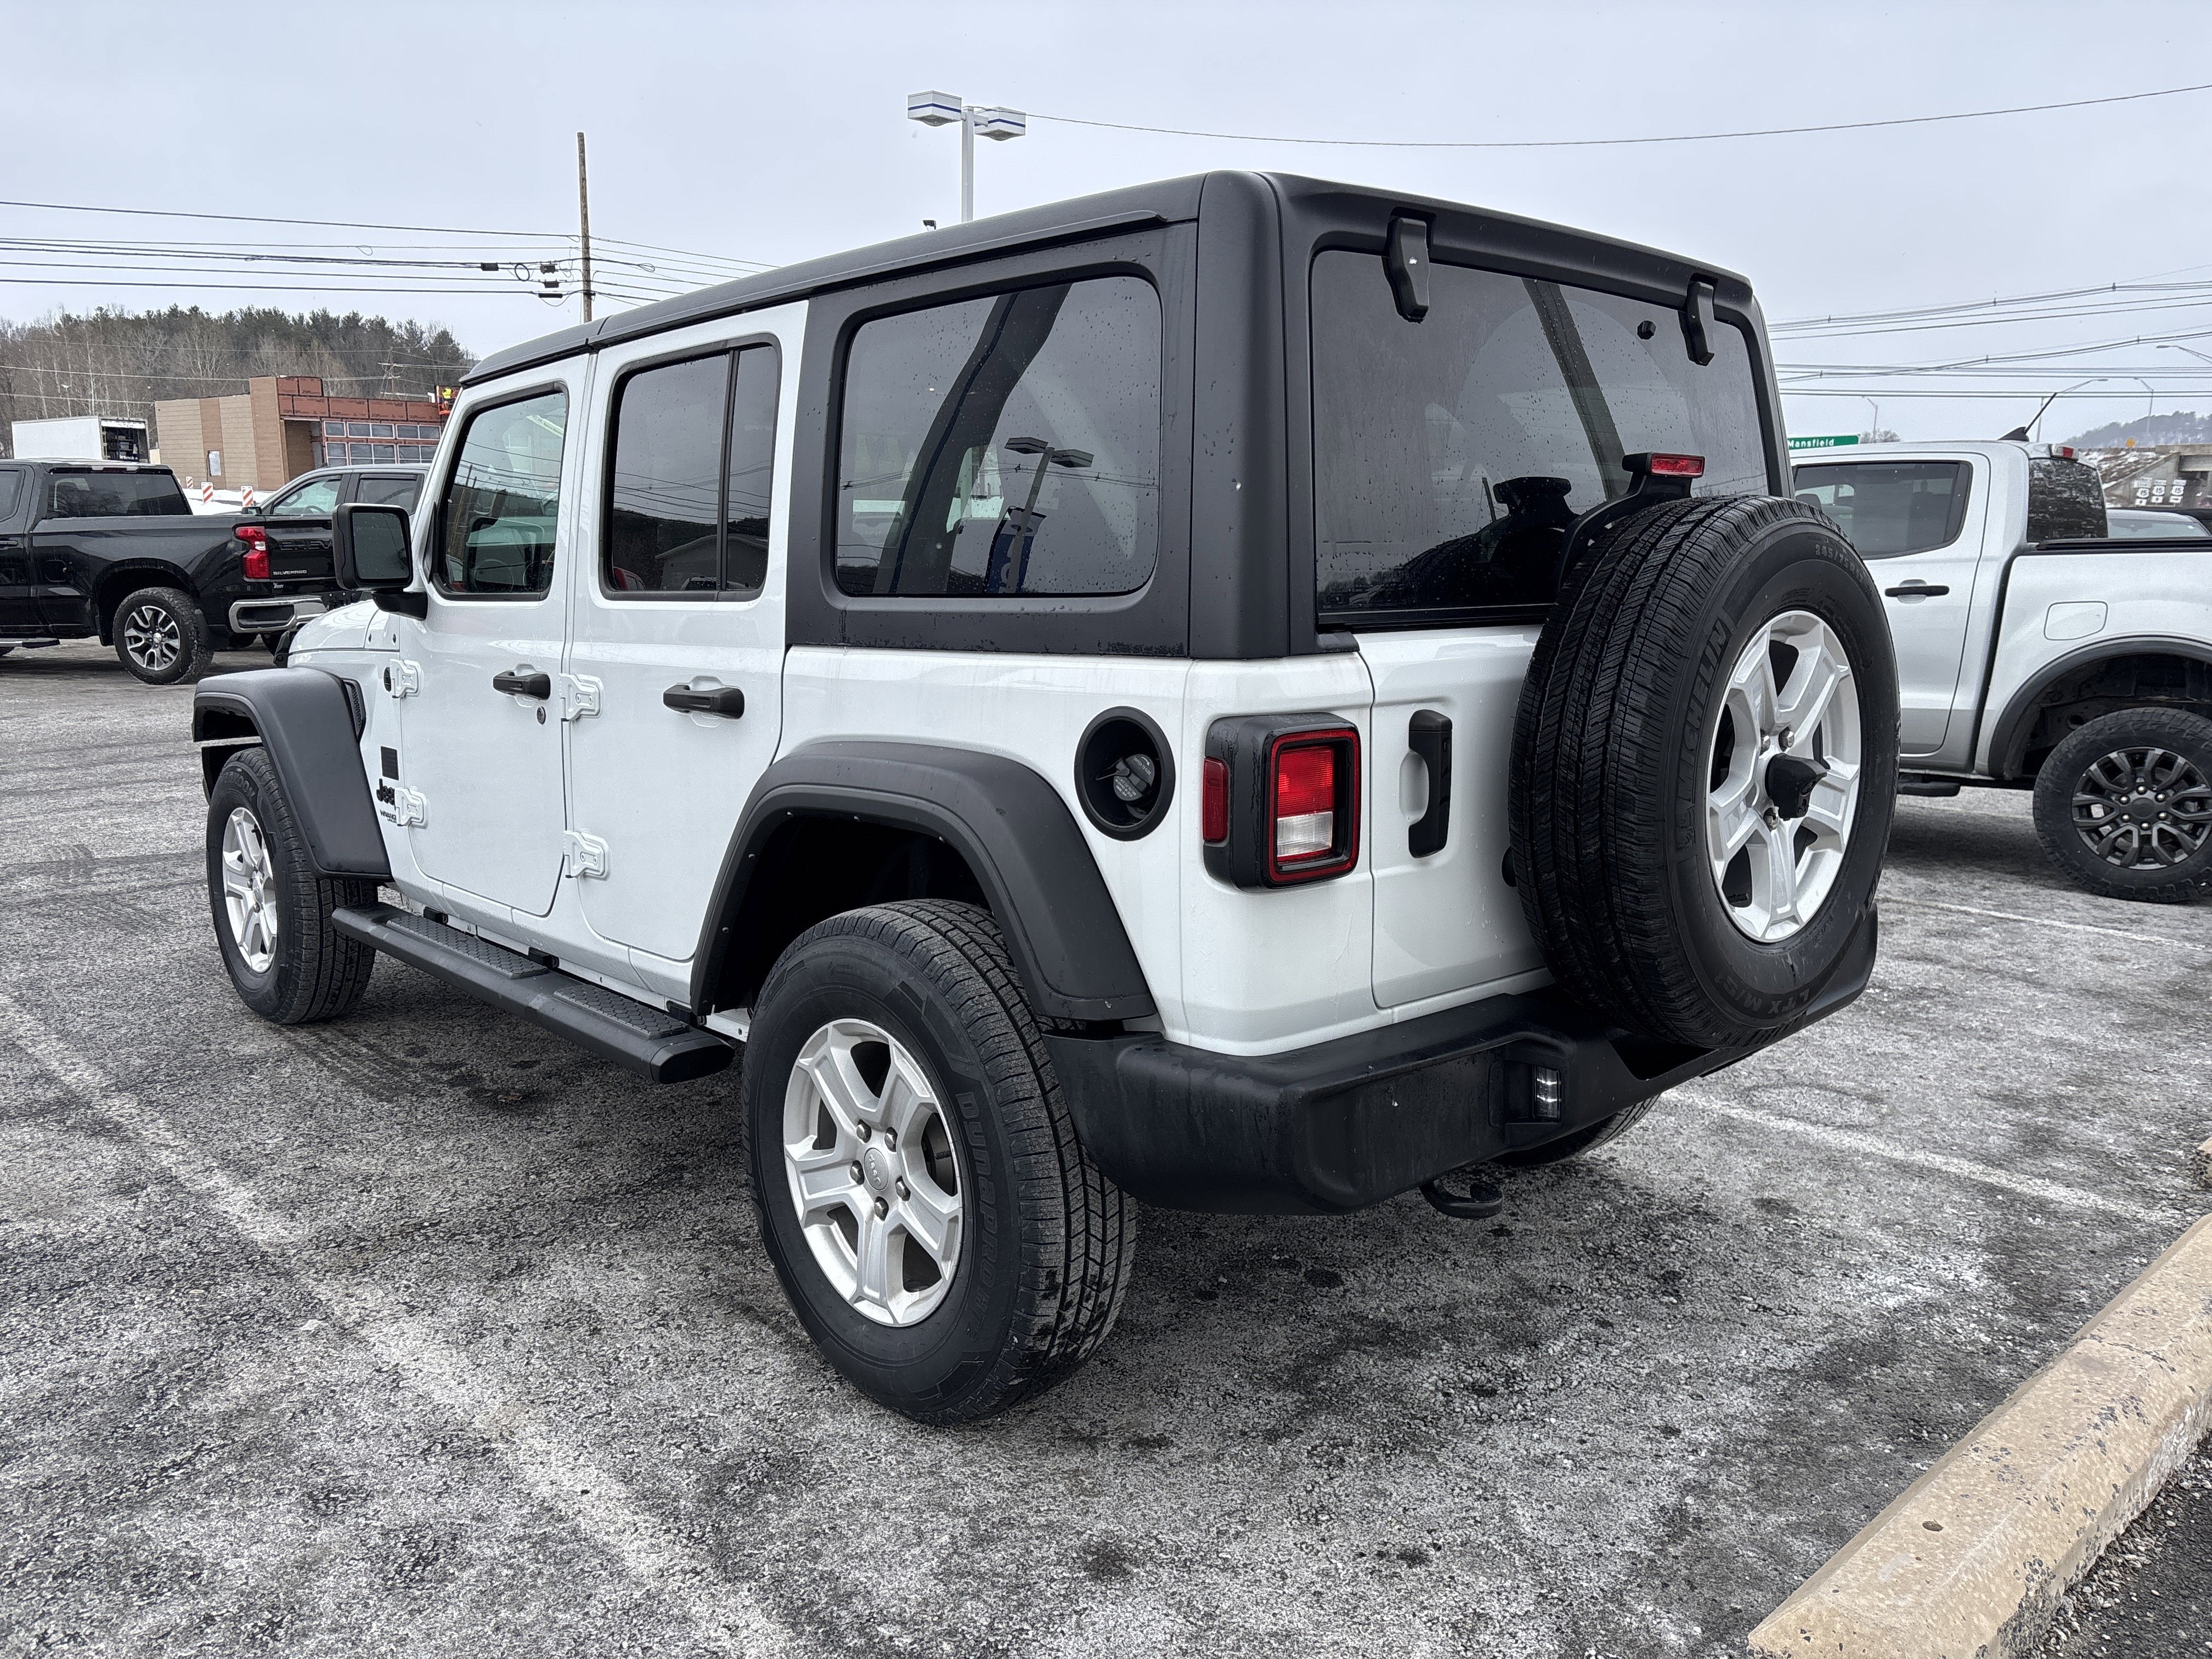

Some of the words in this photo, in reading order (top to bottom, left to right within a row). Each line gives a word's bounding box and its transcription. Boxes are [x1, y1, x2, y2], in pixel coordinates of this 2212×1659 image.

[1787, 438, 1835, 448] Mansfield
[1678, 617, 1731, 802] MICHELIN
[1768, 988, 1810, 1014] LTX
